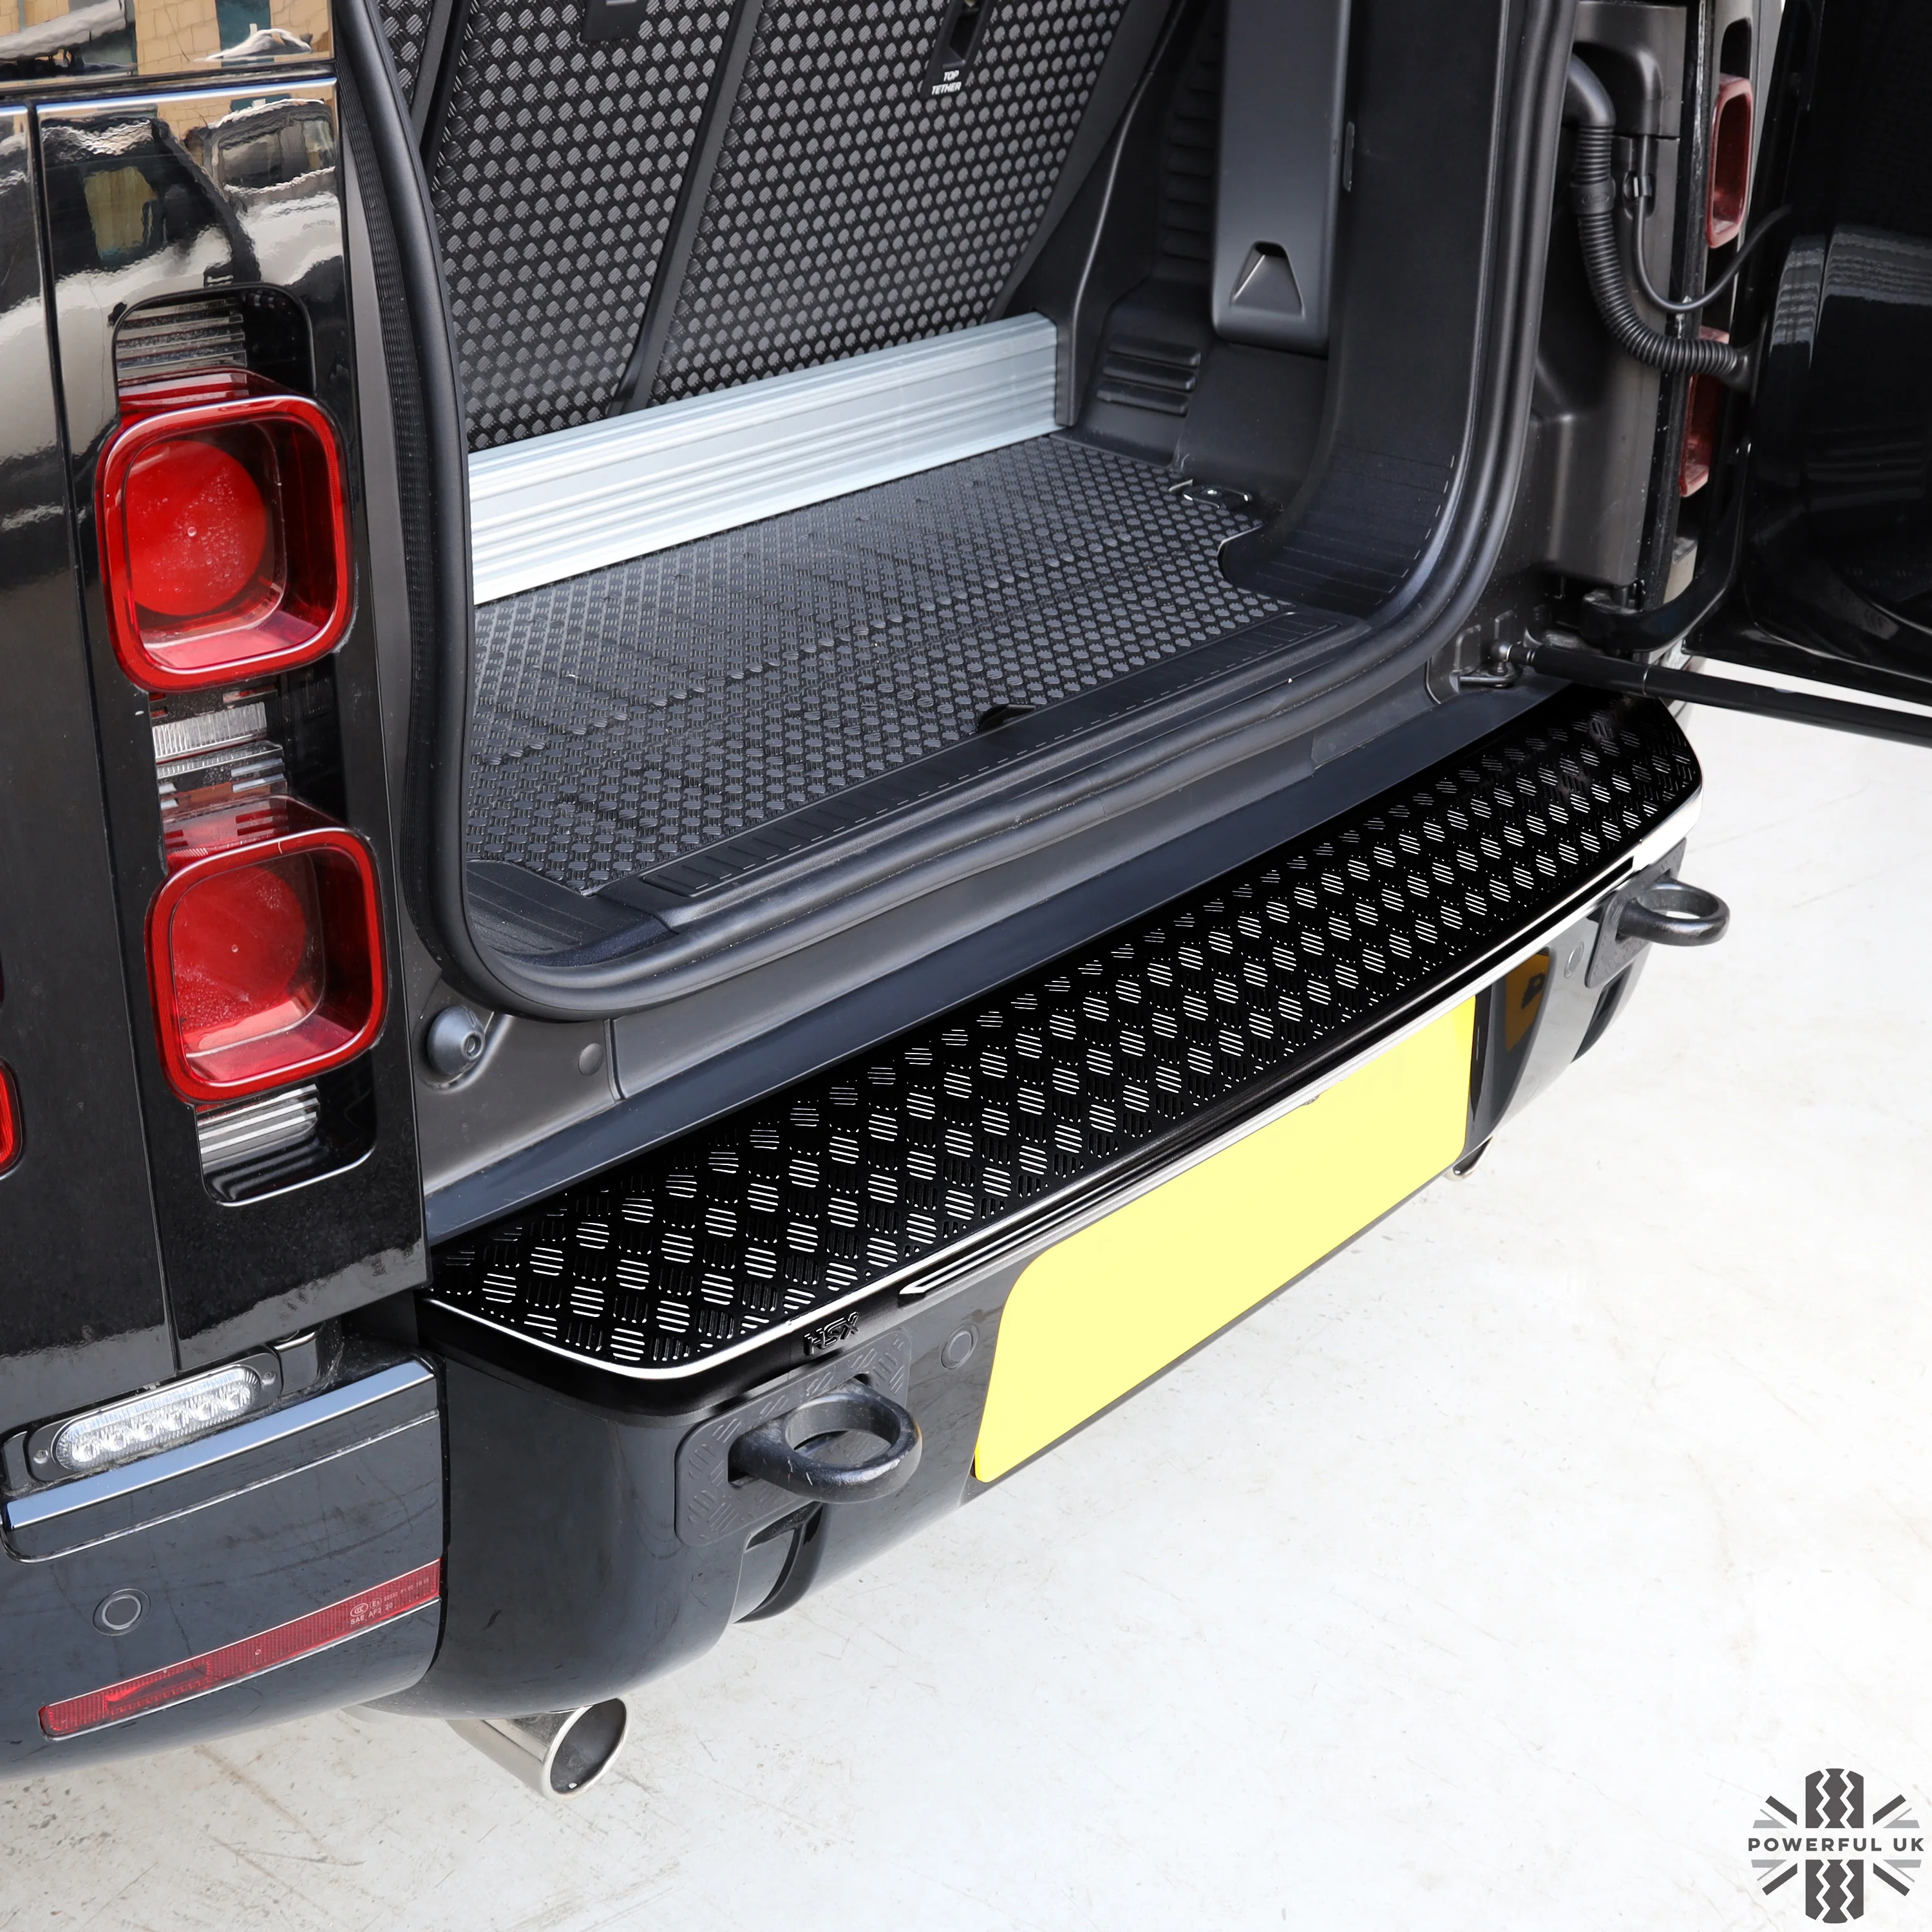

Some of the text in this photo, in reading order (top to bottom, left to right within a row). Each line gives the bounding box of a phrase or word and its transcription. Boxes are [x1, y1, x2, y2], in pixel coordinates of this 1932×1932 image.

[943, 70, 960, 82] TOP
[931, 81, 962, 95] TETHER
[350, 1602, 393, 1625] SAE AF2 20
